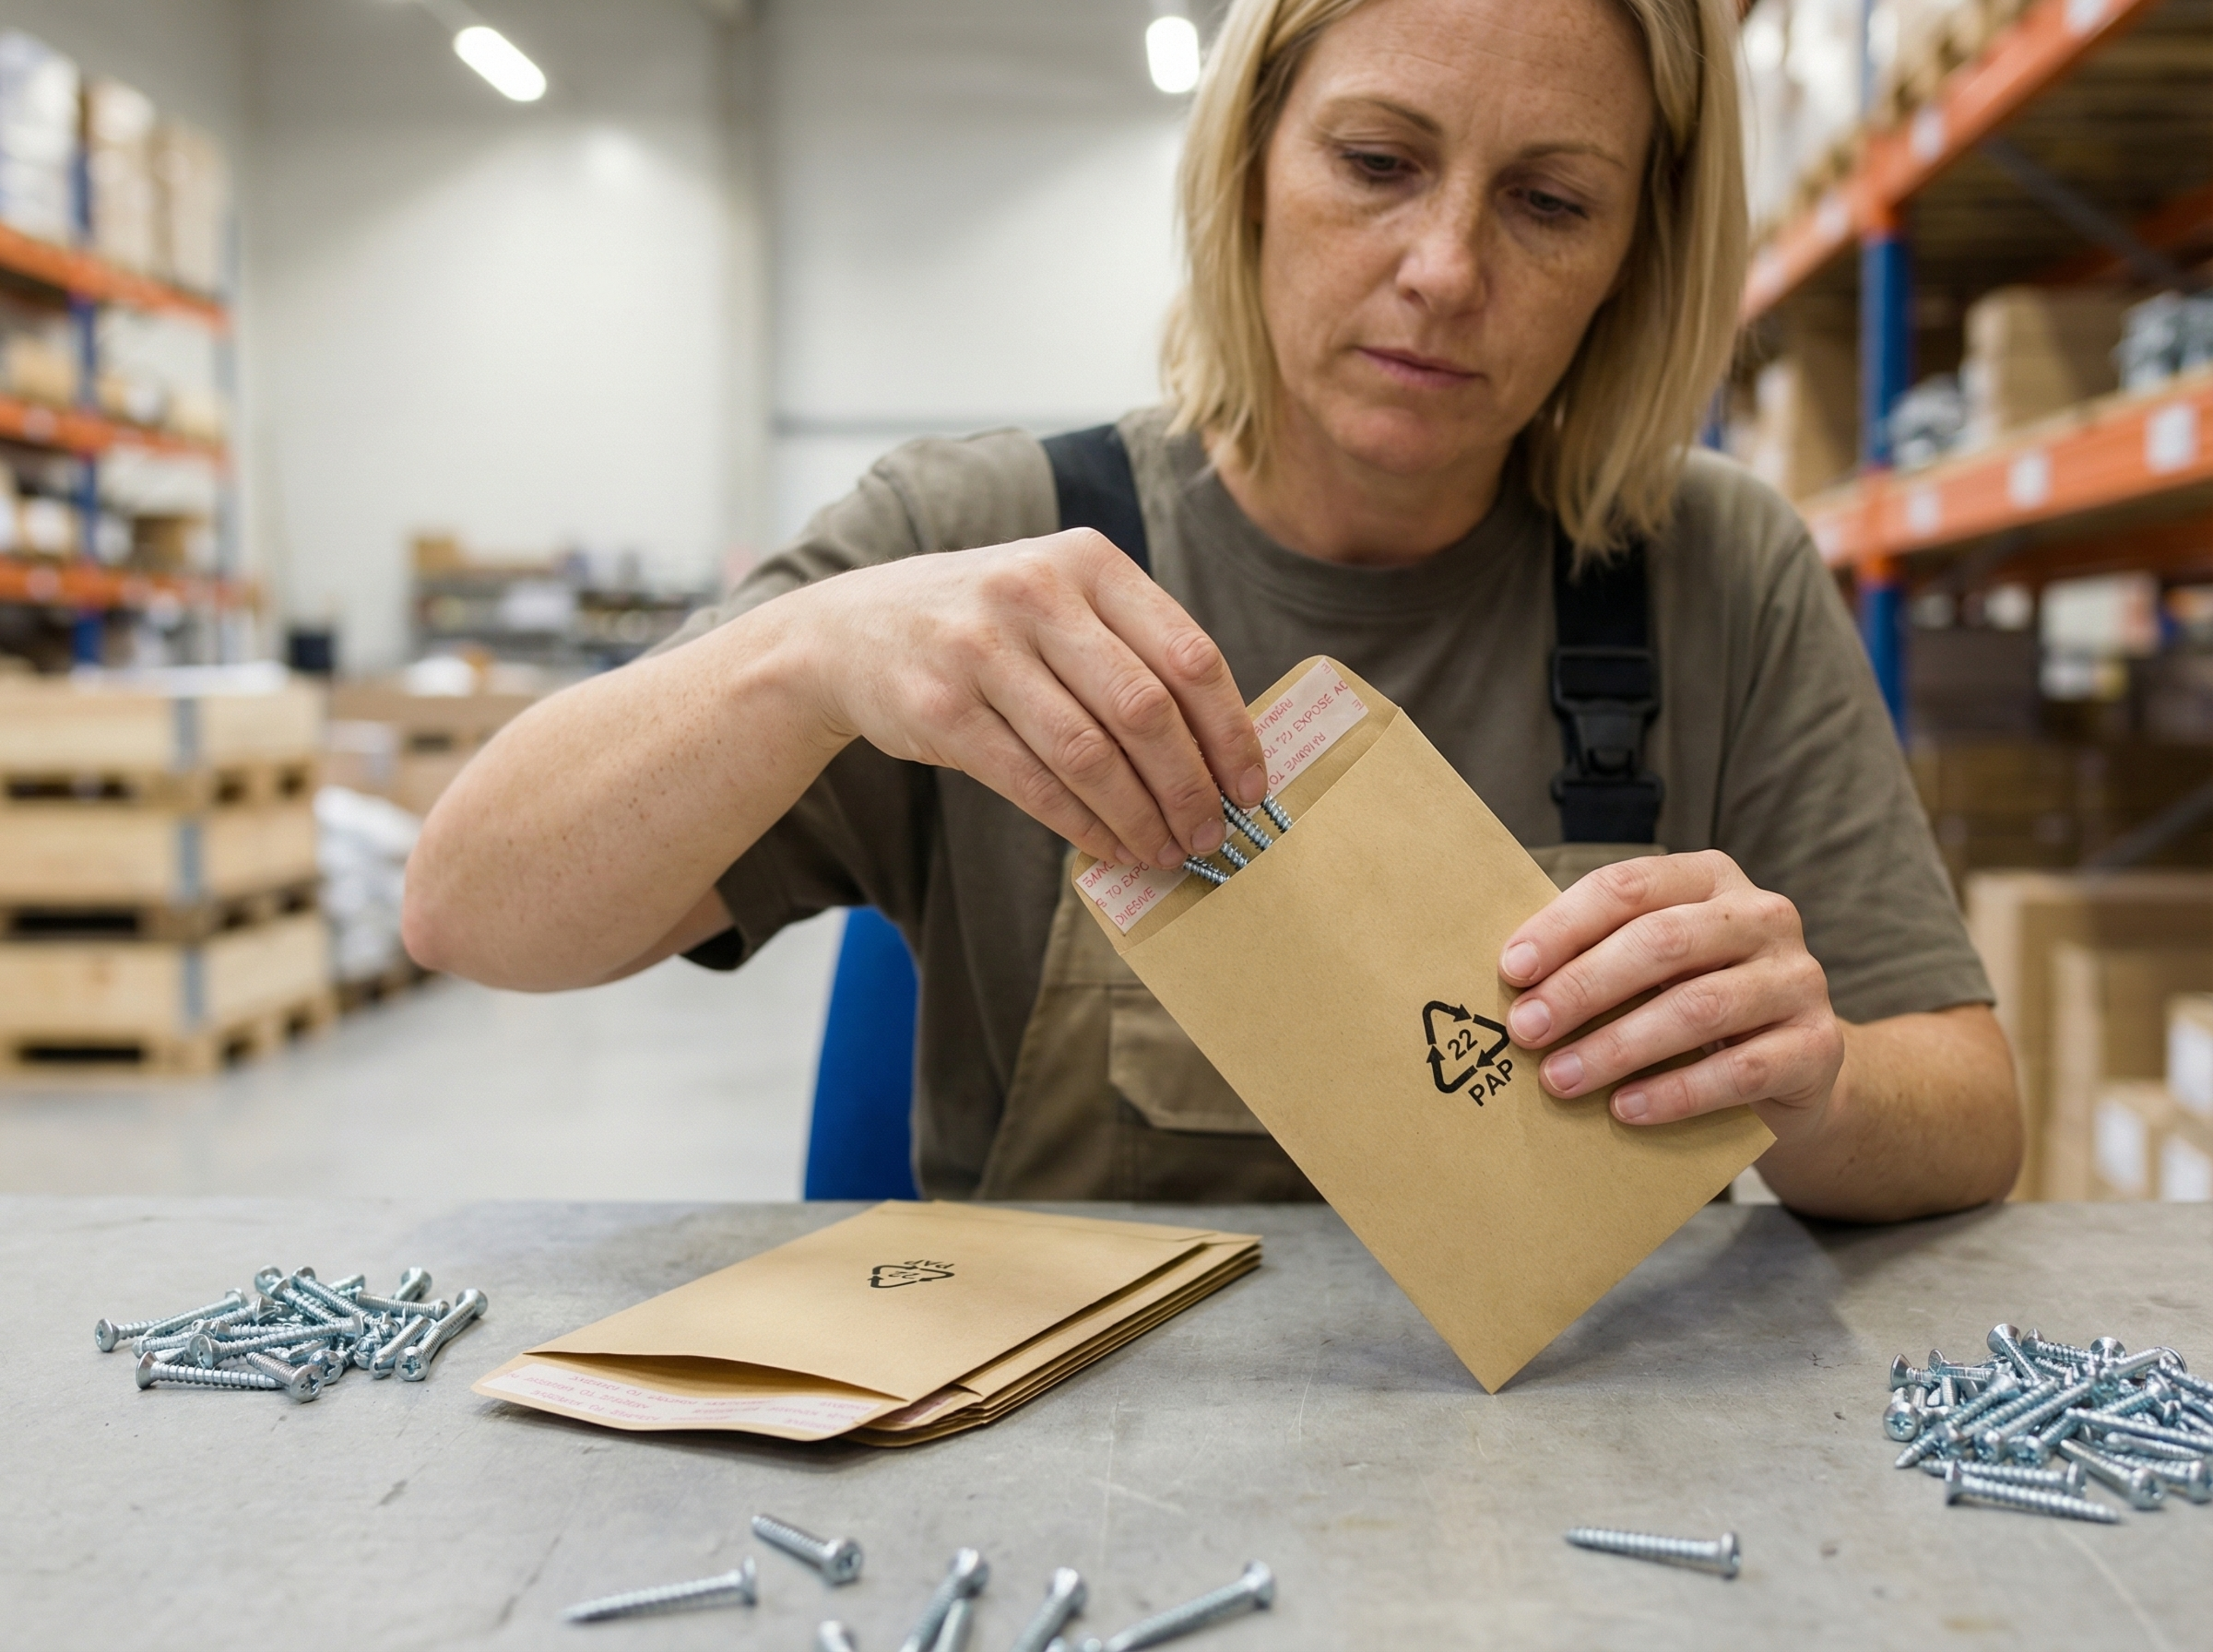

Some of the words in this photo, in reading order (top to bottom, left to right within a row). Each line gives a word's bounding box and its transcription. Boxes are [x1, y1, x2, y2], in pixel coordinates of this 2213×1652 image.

[1293, 693, 1334, 733] EXPOSE
[1447, 1029, 1478, 1061] 22
[1468, 1059, 1513, 1107] PAP
